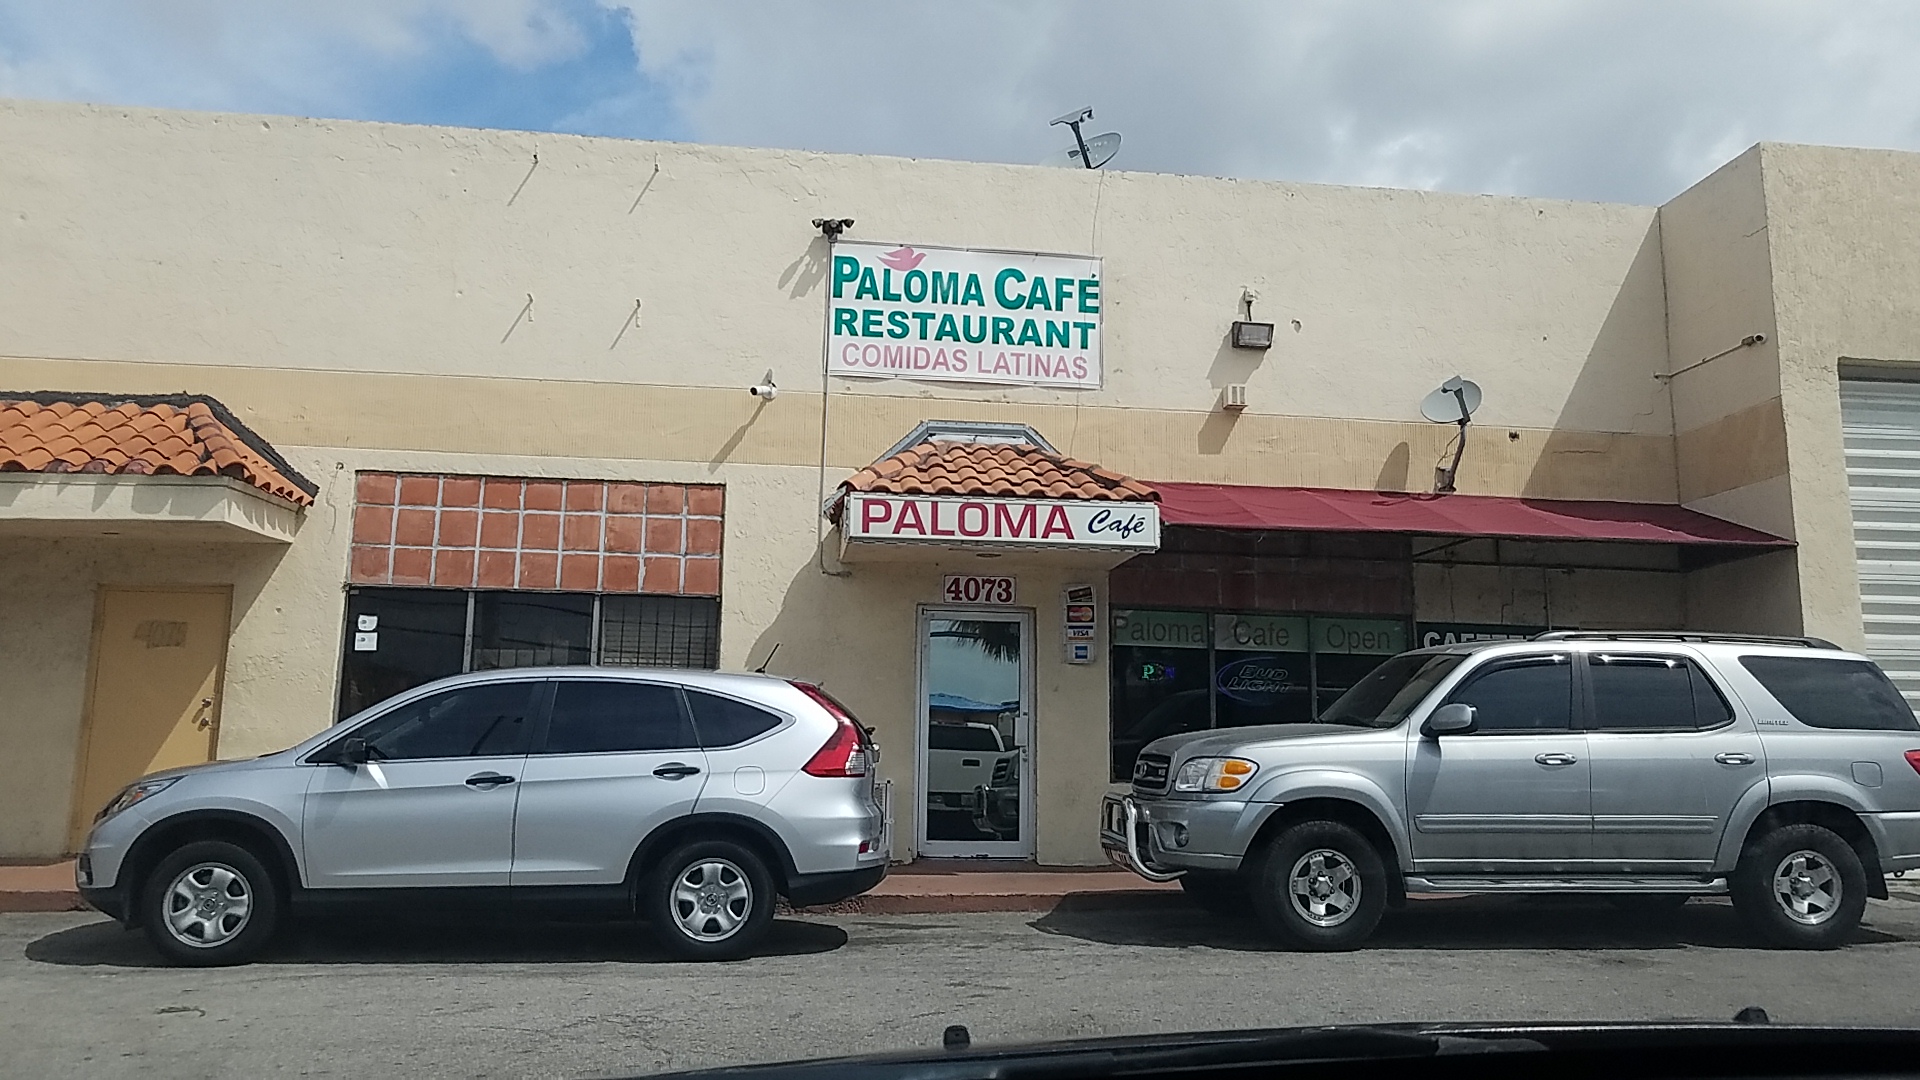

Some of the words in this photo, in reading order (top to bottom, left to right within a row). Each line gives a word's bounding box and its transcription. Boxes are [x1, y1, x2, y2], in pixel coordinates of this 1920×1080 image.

[832, 254, 986, 307] PALOMA
[994, 267, 1100, 314] CAFÉ
[833, 307, 1096, 350] RESTAURANT
[842, 342, 968, 373] COMIDAS
[977, 351, 1088, 380] LATINAS
[861, 499, 1075, 540] PALOMA
[1088, 509, 1146, 540] Café
[945, 577, 1013, 603] 4073
[1072, 629, 1090, 637] VISA
[1114, 615, 1206, 643] Paloma
[1234, 621, 1290, 647] Cafe
[1327, 624, 1390, 654] Open
[1226, 676, 1294, 693] LIGHT
[1238, 665, 1289, 681] BUD
